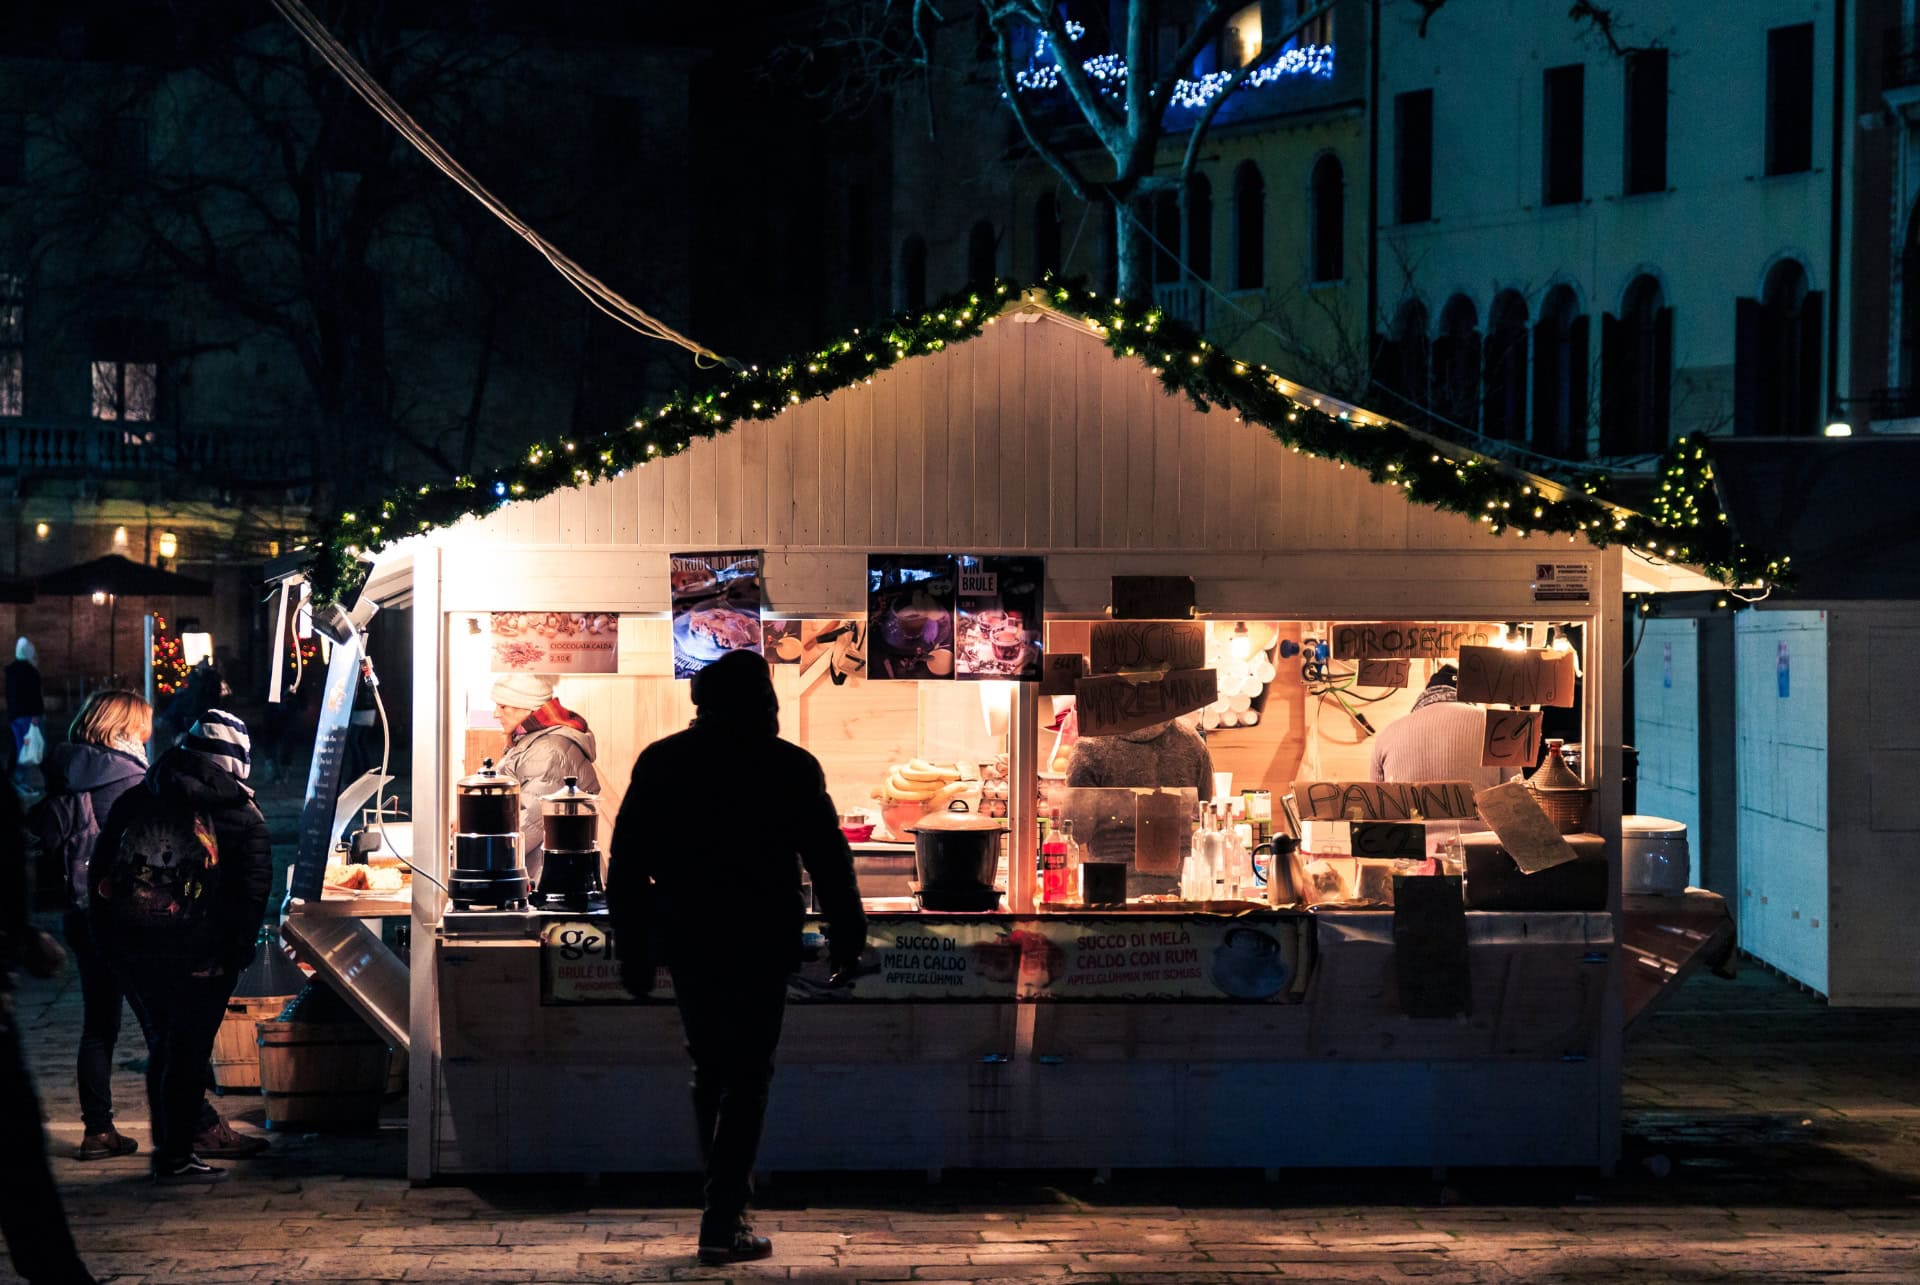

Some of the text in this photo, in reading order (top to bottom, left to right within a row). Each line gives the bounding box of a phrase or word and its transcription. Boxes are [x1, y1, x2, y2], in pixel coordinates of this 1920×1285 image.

[1307, 783, 1467, 819] PANINI
[896, 936, 956, 953] SUCCO DI
[1078, 931, 1190, 951] SUCCO DI MELA
[884, 954, 966, 971] MELA CALDO
[1077, 948, 1198, 970] CALDO CON RUM
[1143, 969, 1161, 982] MIT
